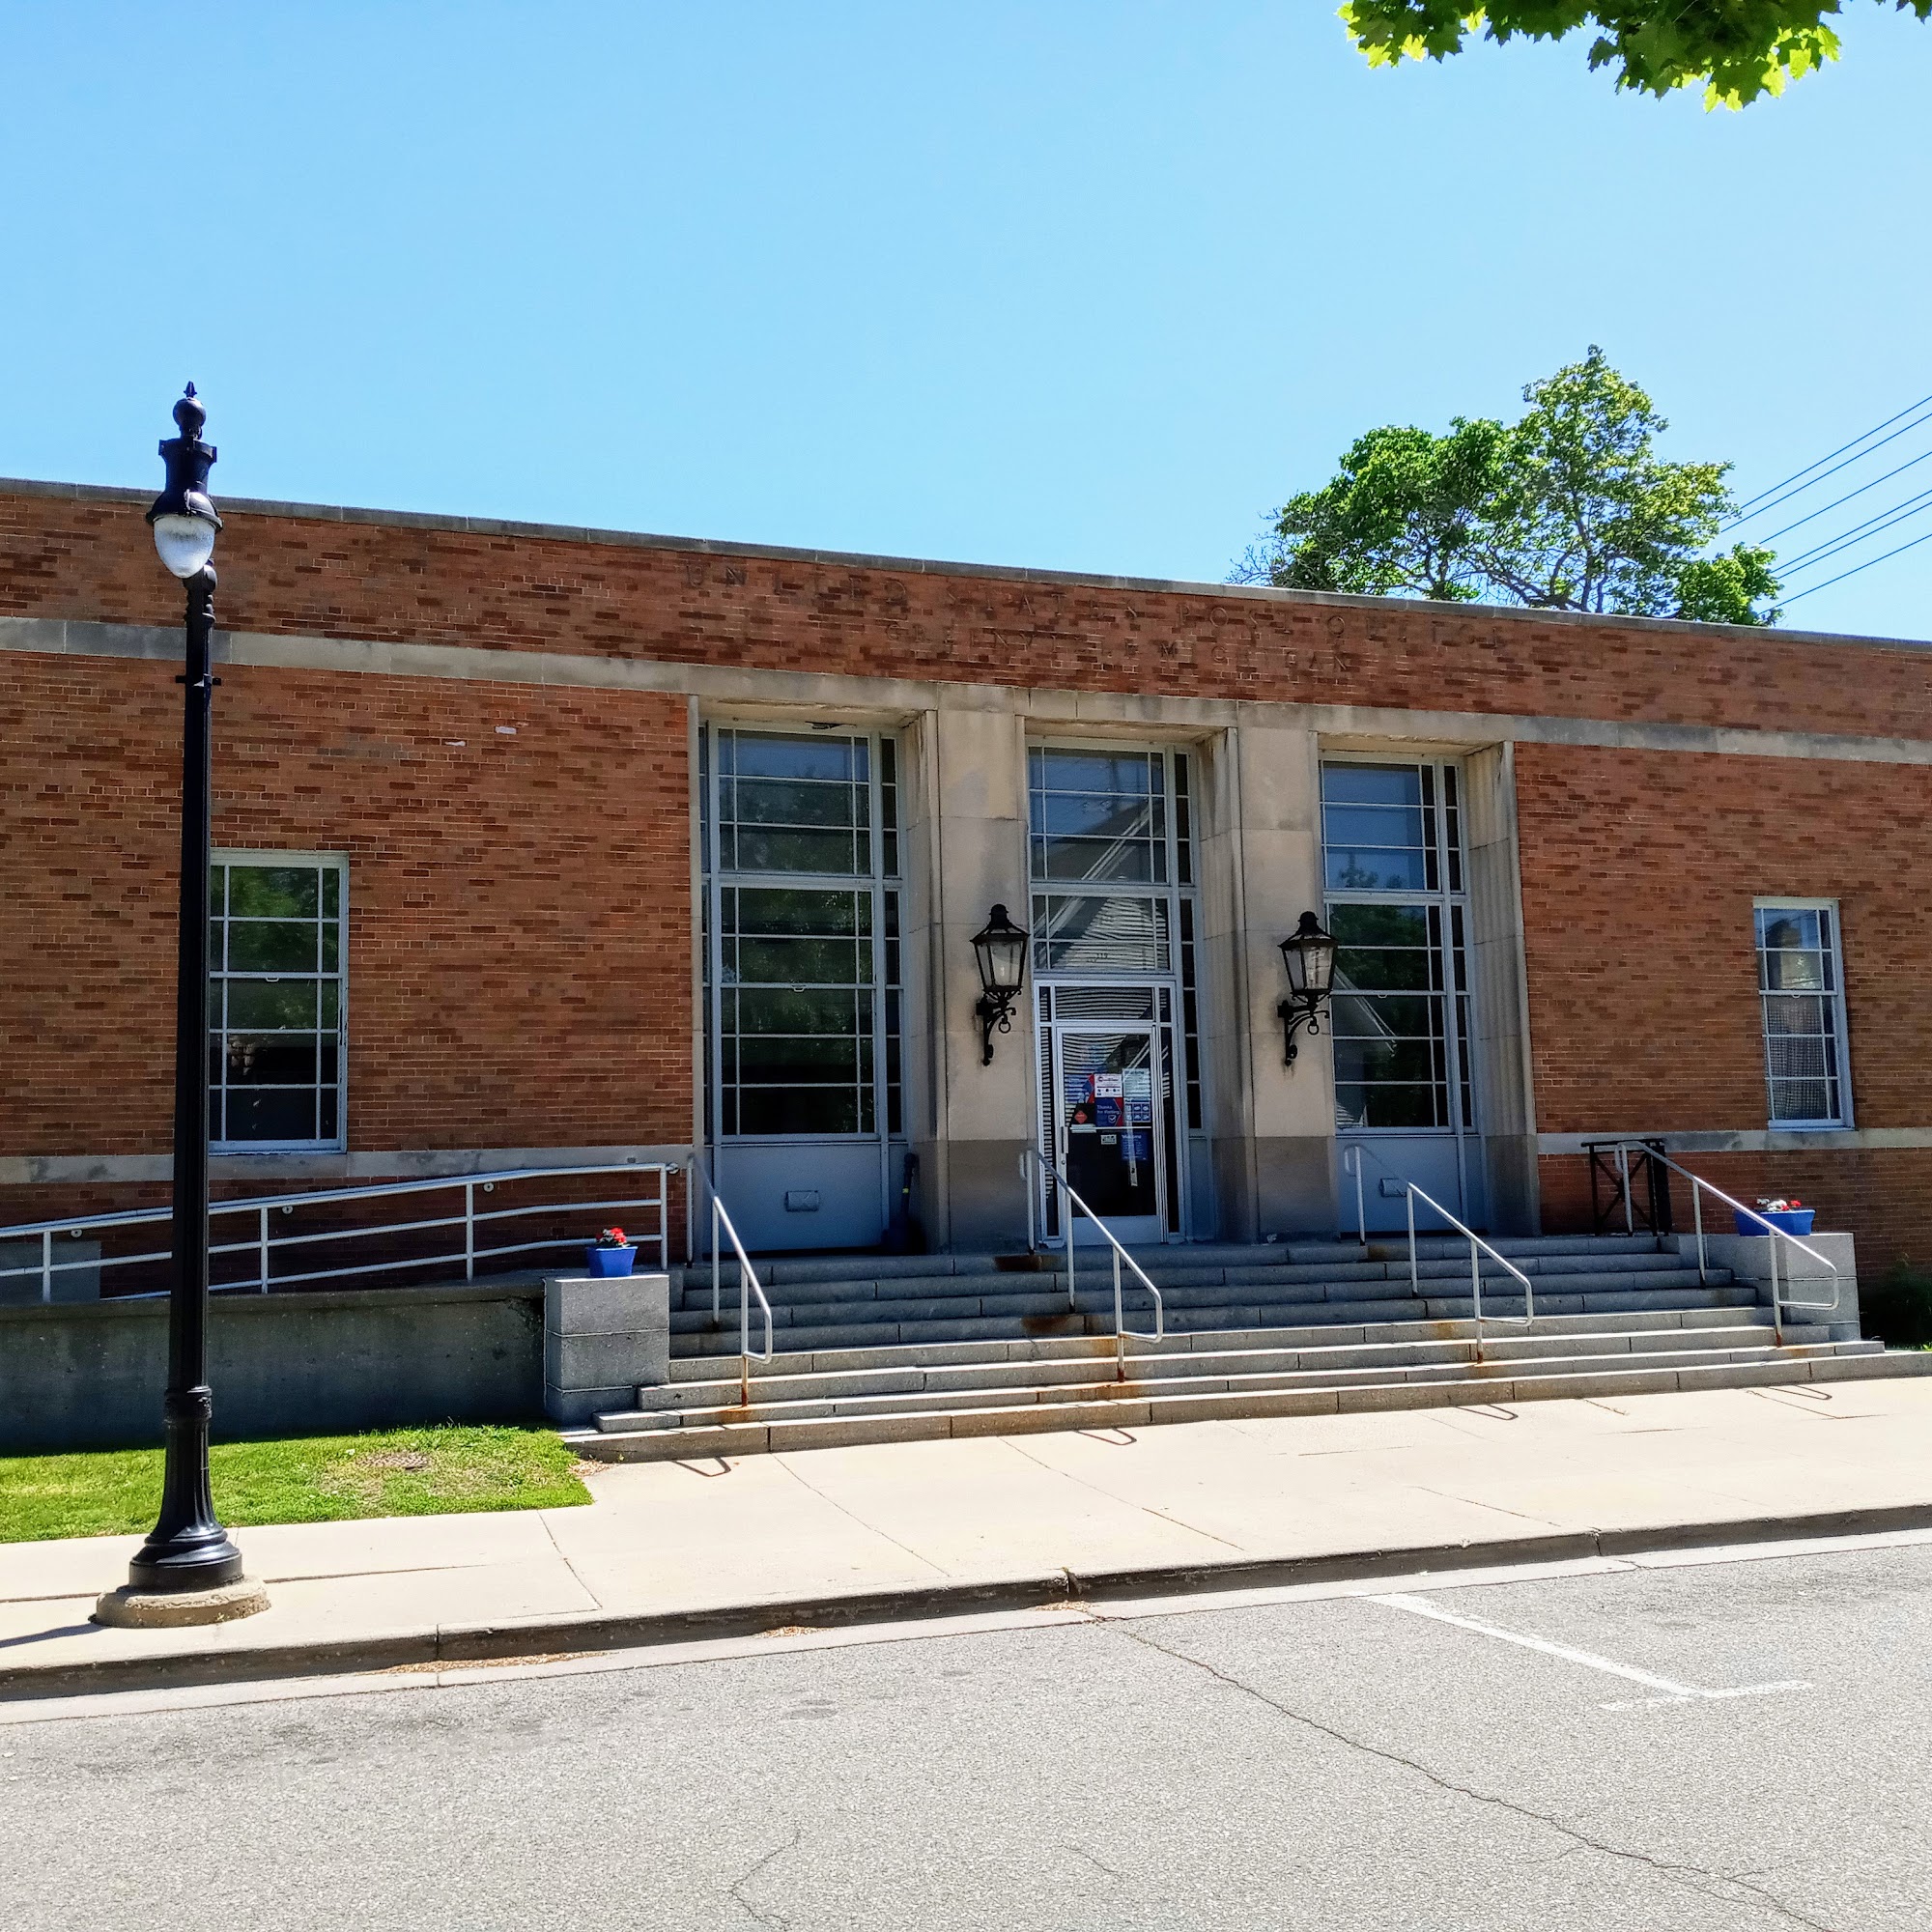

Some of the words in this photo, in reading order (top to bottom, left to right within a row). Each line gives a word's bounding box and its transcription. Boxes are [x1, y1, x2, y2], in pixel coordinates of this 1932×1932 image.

[686, 564, 908, 606] UNITED
[945, 585, 1138, 619] STATES
[1175, 602, 1293, 635] POST
